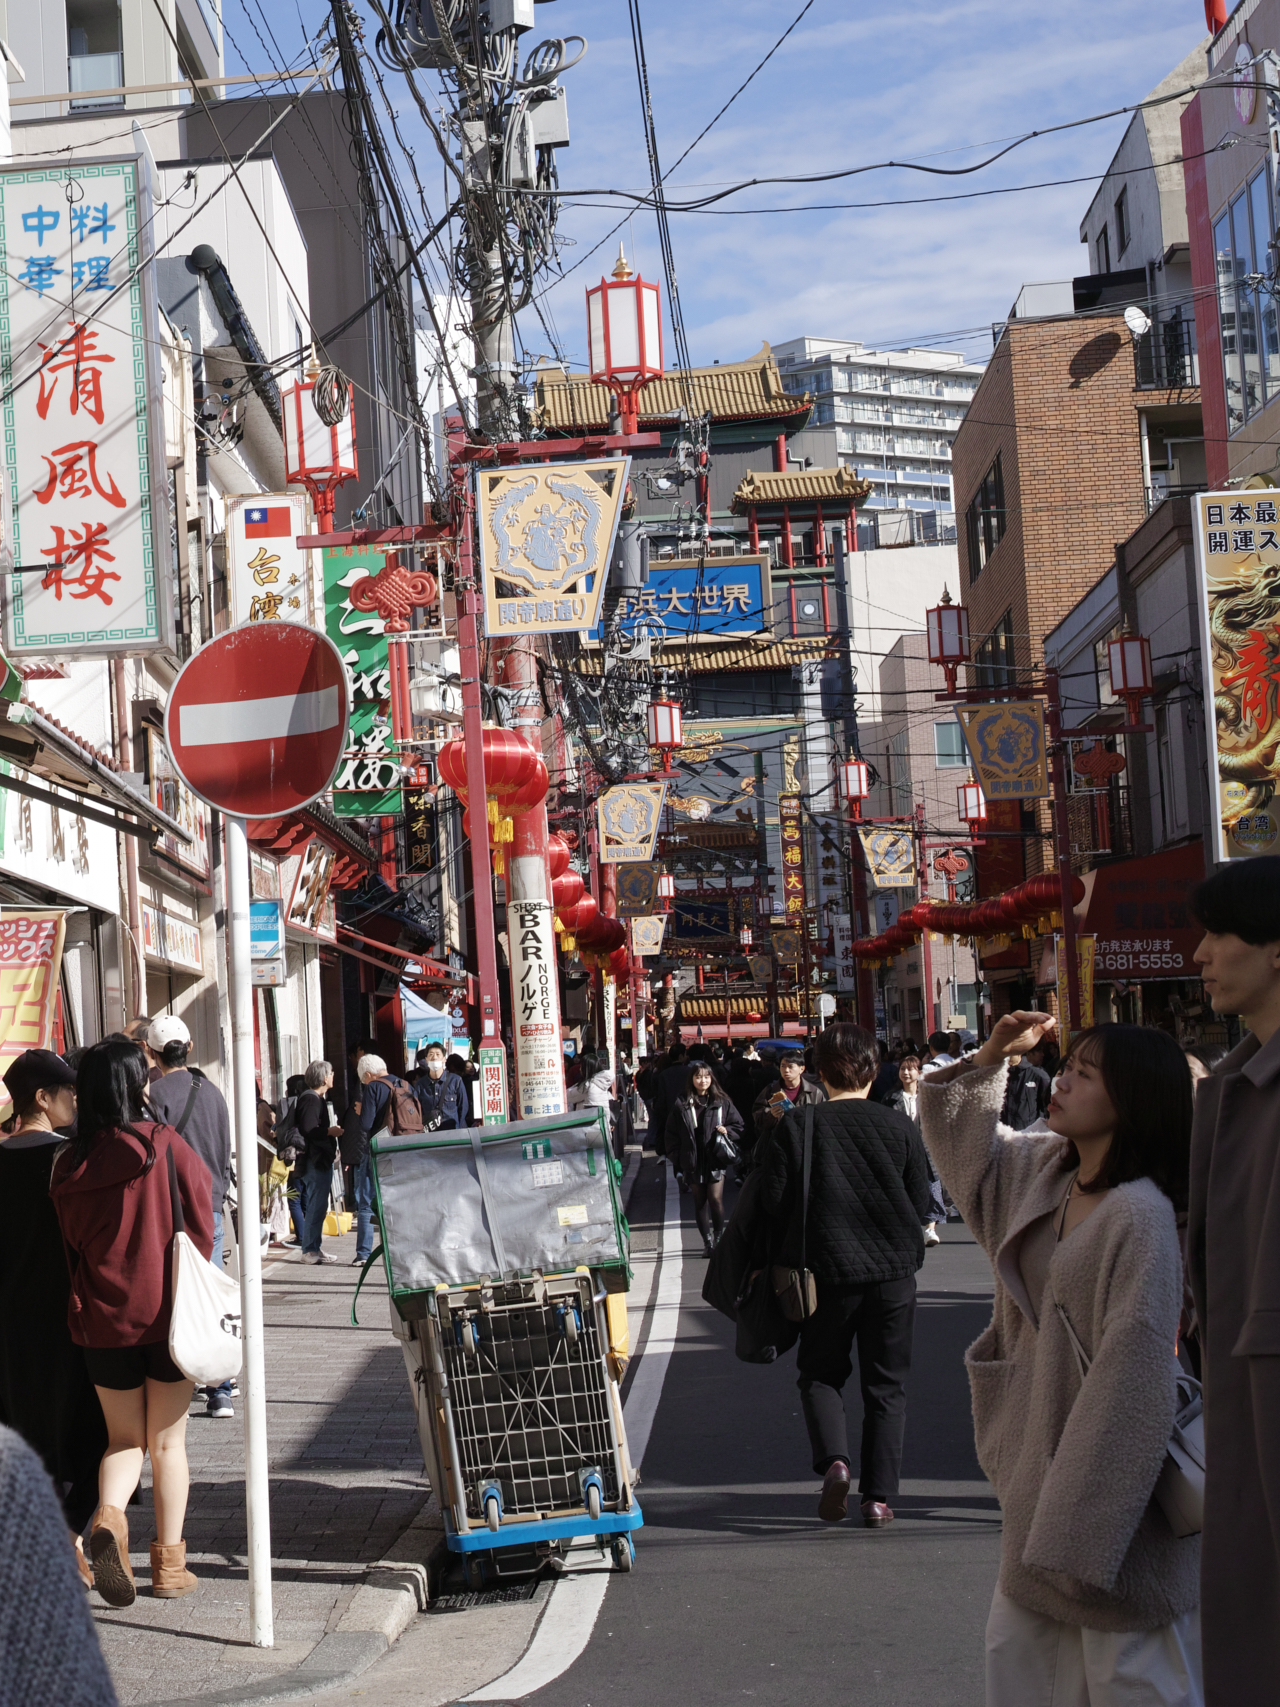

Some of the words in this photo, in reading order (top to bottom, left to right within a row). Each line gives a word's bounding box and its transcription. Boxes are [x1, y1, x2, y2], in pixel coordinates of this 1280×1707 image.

[18, 204, 63, 298] 中華
[70, 202, 117, 293] 料理
[32, 322, 127, 606] 清風楼
[1206, 500, 1280, 525] 日本最
[326, 542, 385, 558] 上海料理
[248, 546, 283, 621] 台湾
[499, 598, 587, 626] 関帝廟通り
[990, 779, 1043, 794] 関帝廟通り
[1236, 814, 1269, 831] 台湾
[606, 847, 647, 858] 関帝廟通り
[878, 873, 915, 885] 関帝廟通り
[519, 913, 543, 961] BAR
[1105, 953, 1184, 970] 681-5553
[519, 964, 537, 1021] ノルゲ
[538, 963, 550, 1020] NORGE
[485, 1066, 502, 1113] 関帝廟
[524, 1103, 561, 1115] 車に注意
